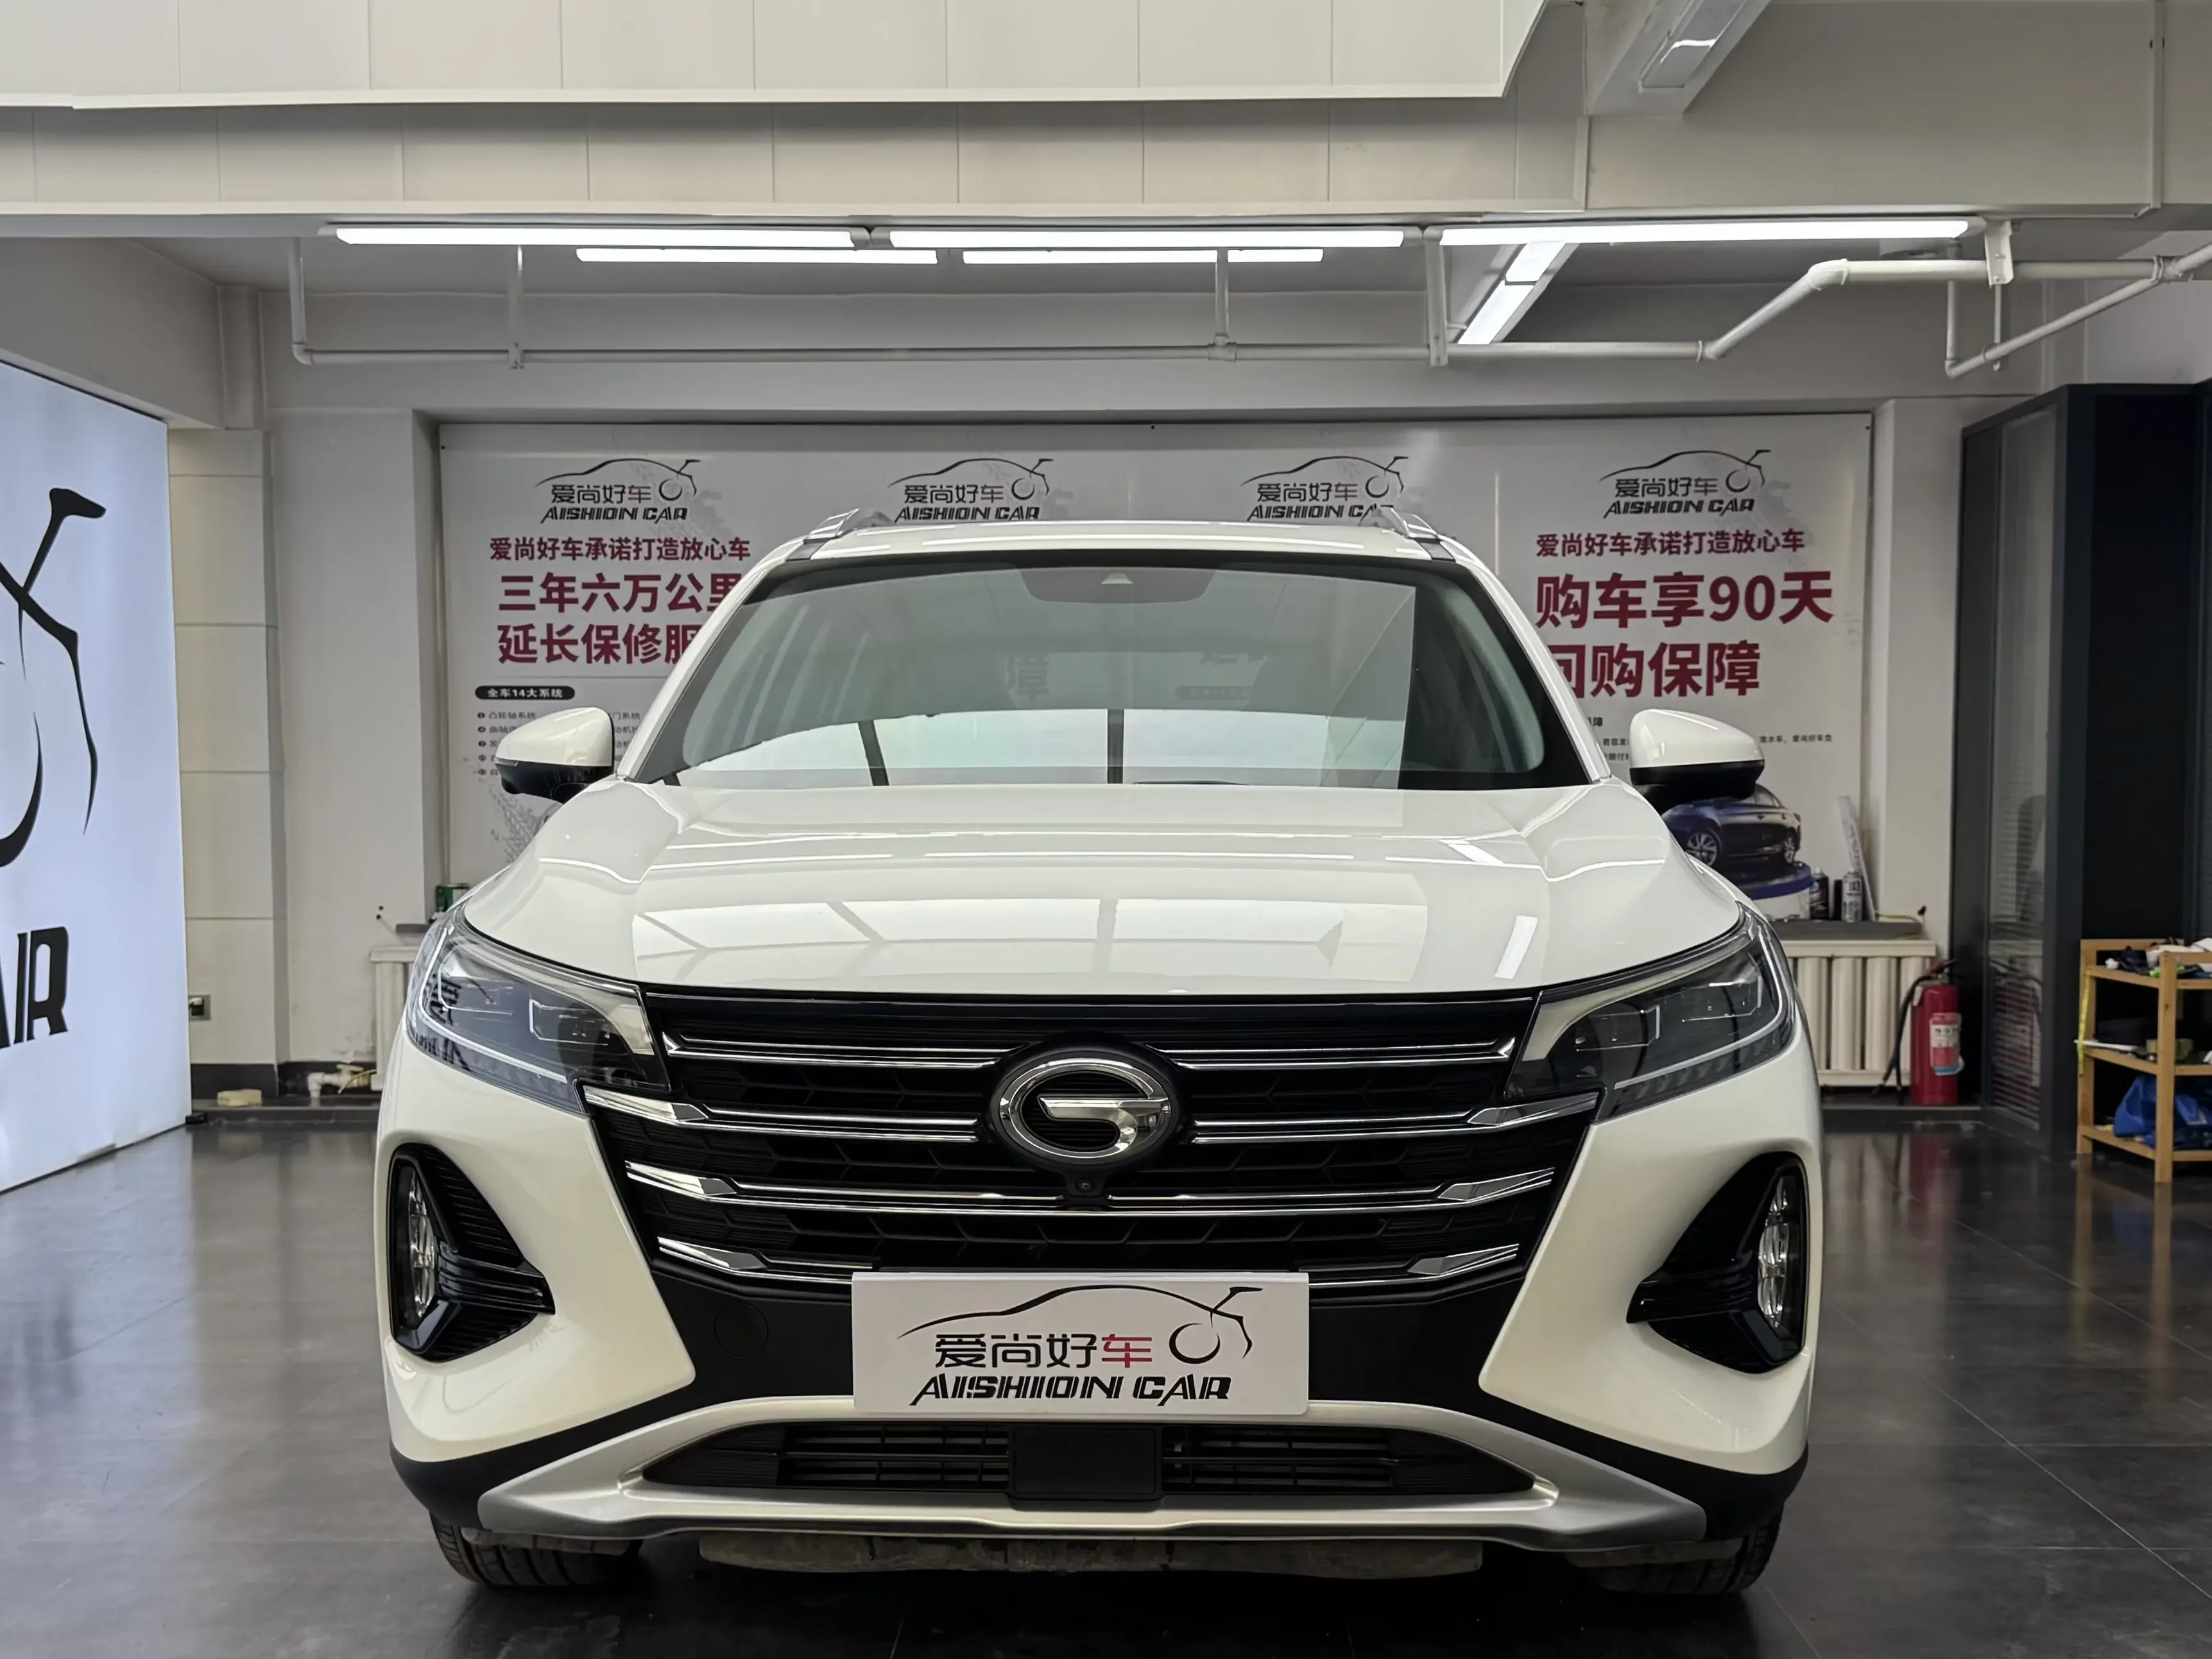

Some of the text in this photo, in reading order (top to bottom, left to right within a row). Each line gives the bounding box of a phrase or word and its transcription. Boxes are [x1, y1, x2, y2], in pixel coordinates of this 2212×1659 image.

[551, 484, 652, 504] 爱尚好车
[904, 484, 1004, 504] 爱尚好车
[1257, 482, 1358, 502] 爱尚好车
[1615, 477, 1718, 498] 爱尚好车
[540, 506, 688, 524] AISHION CAR
[895, 506, 1040, 523] AISHION CAR
[1247, 504, 1344, 522] AISHION
[1602, 498, 1754, 518] AISHION CAR
[490, 536, 751, 561] 爱尚好车承诺打造放心车
[1536, 529, 1805, 557] 爱尚好车承诺打造放心车
[1535, 570, 1833, 629] 购车享90天
[935, 1333, 1153, 1368] 爱尚好车
[909, 1374, 1231, 1406] AISHION CAR
